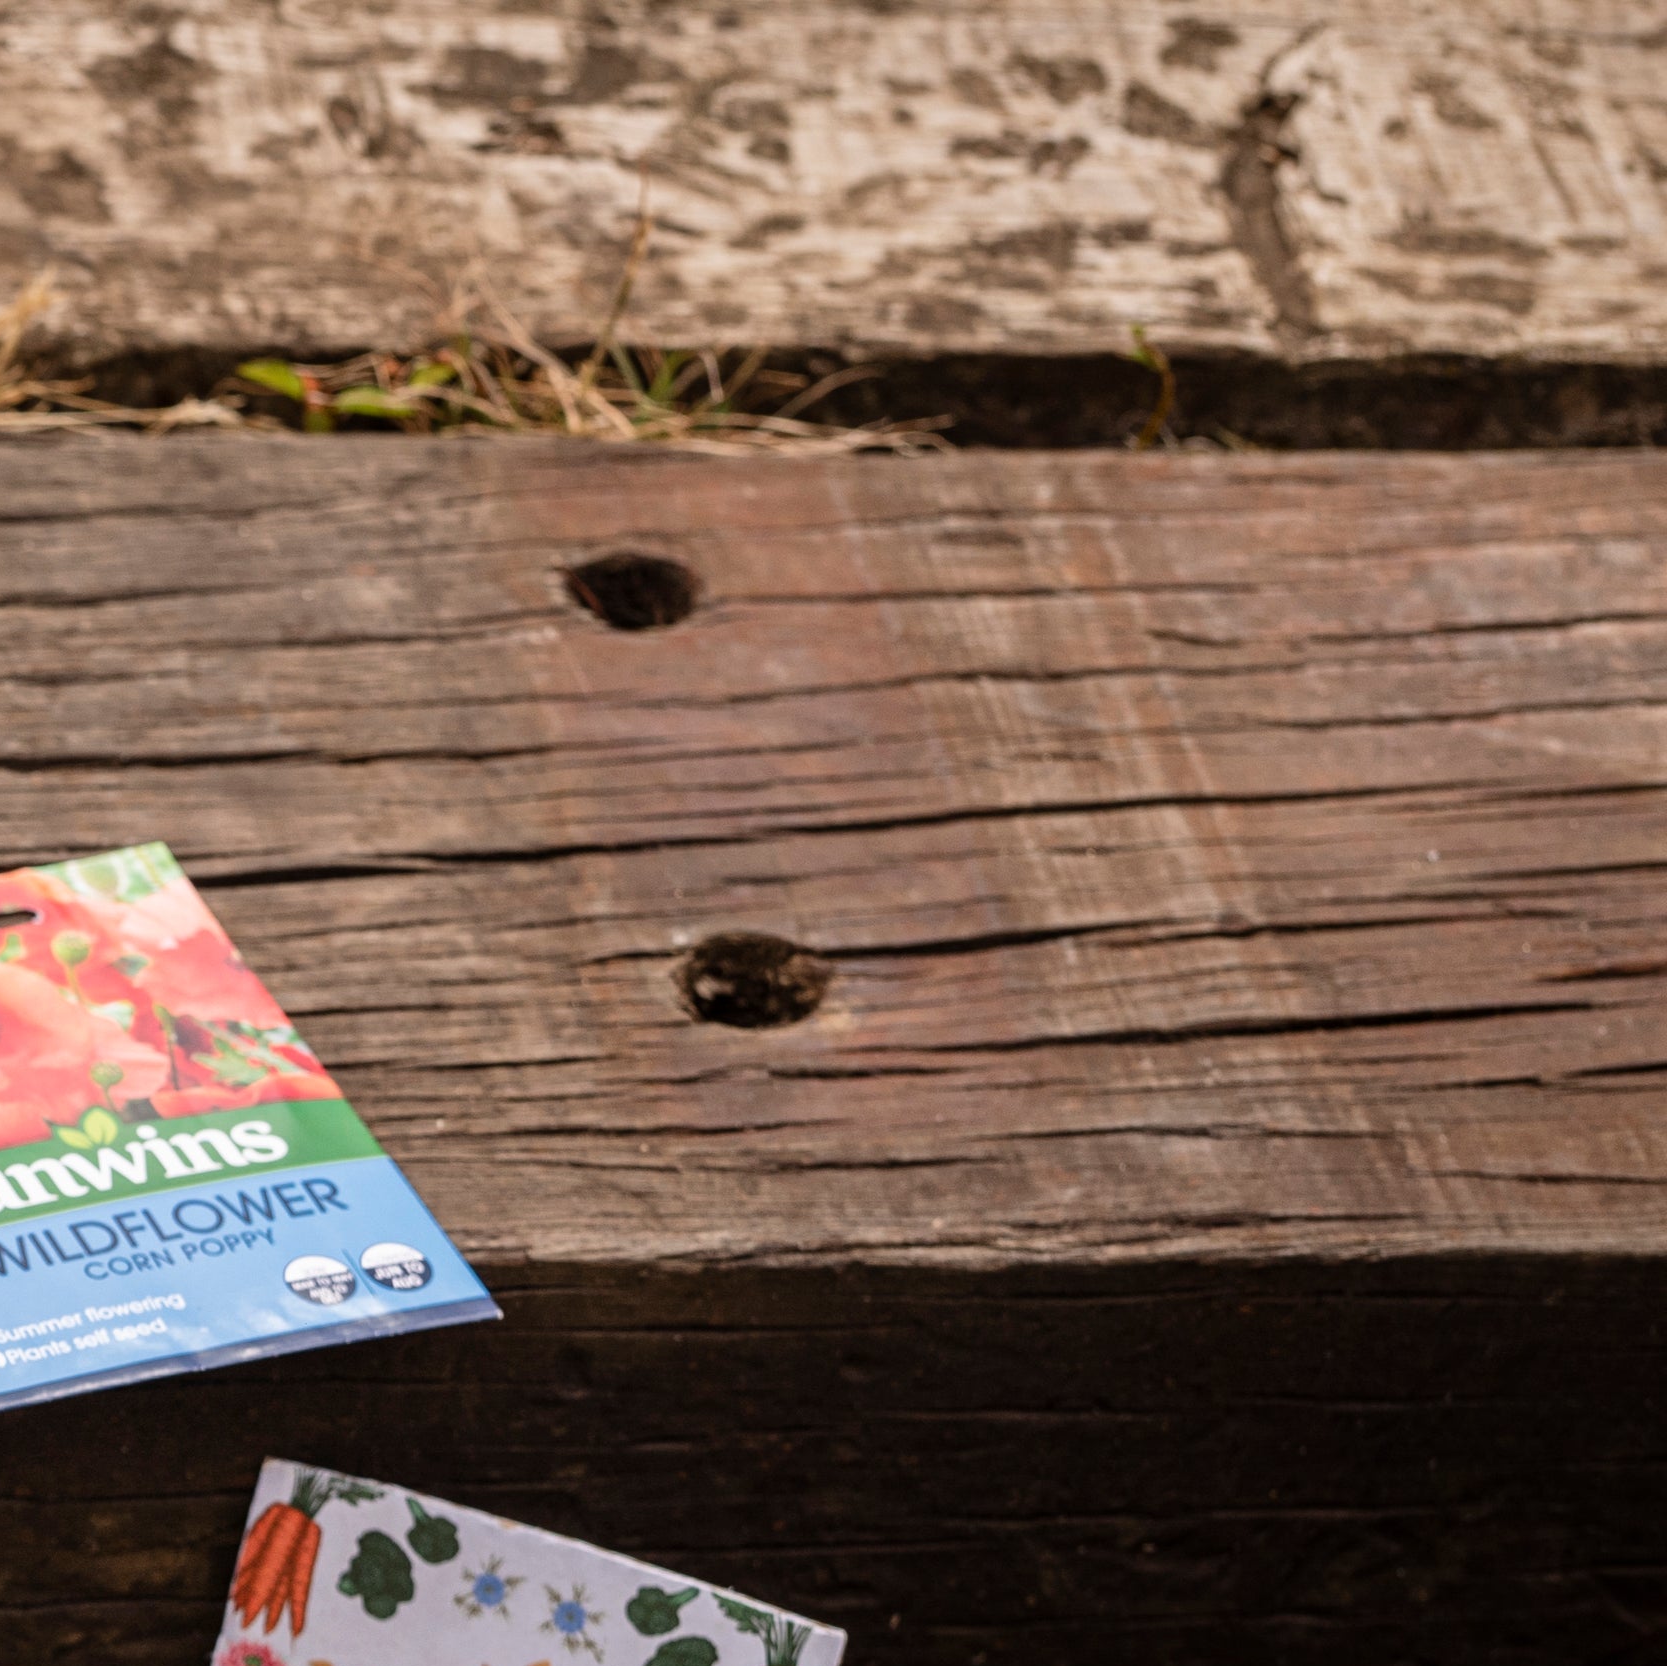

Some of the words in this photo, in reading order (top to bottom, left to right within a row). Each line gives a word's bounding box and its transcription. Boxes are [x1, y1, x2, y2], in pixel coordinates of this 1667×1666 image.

[83, 1247, 176, 1281] CORN
[182, 1227, 276, 1263] POPPY
[84, 1293, 186, 1322] flowering
[4, 1339, 72, 1365] Plants
[73, 1327, 110, 1350] self
[113, 1316, 167, 1342] seed
